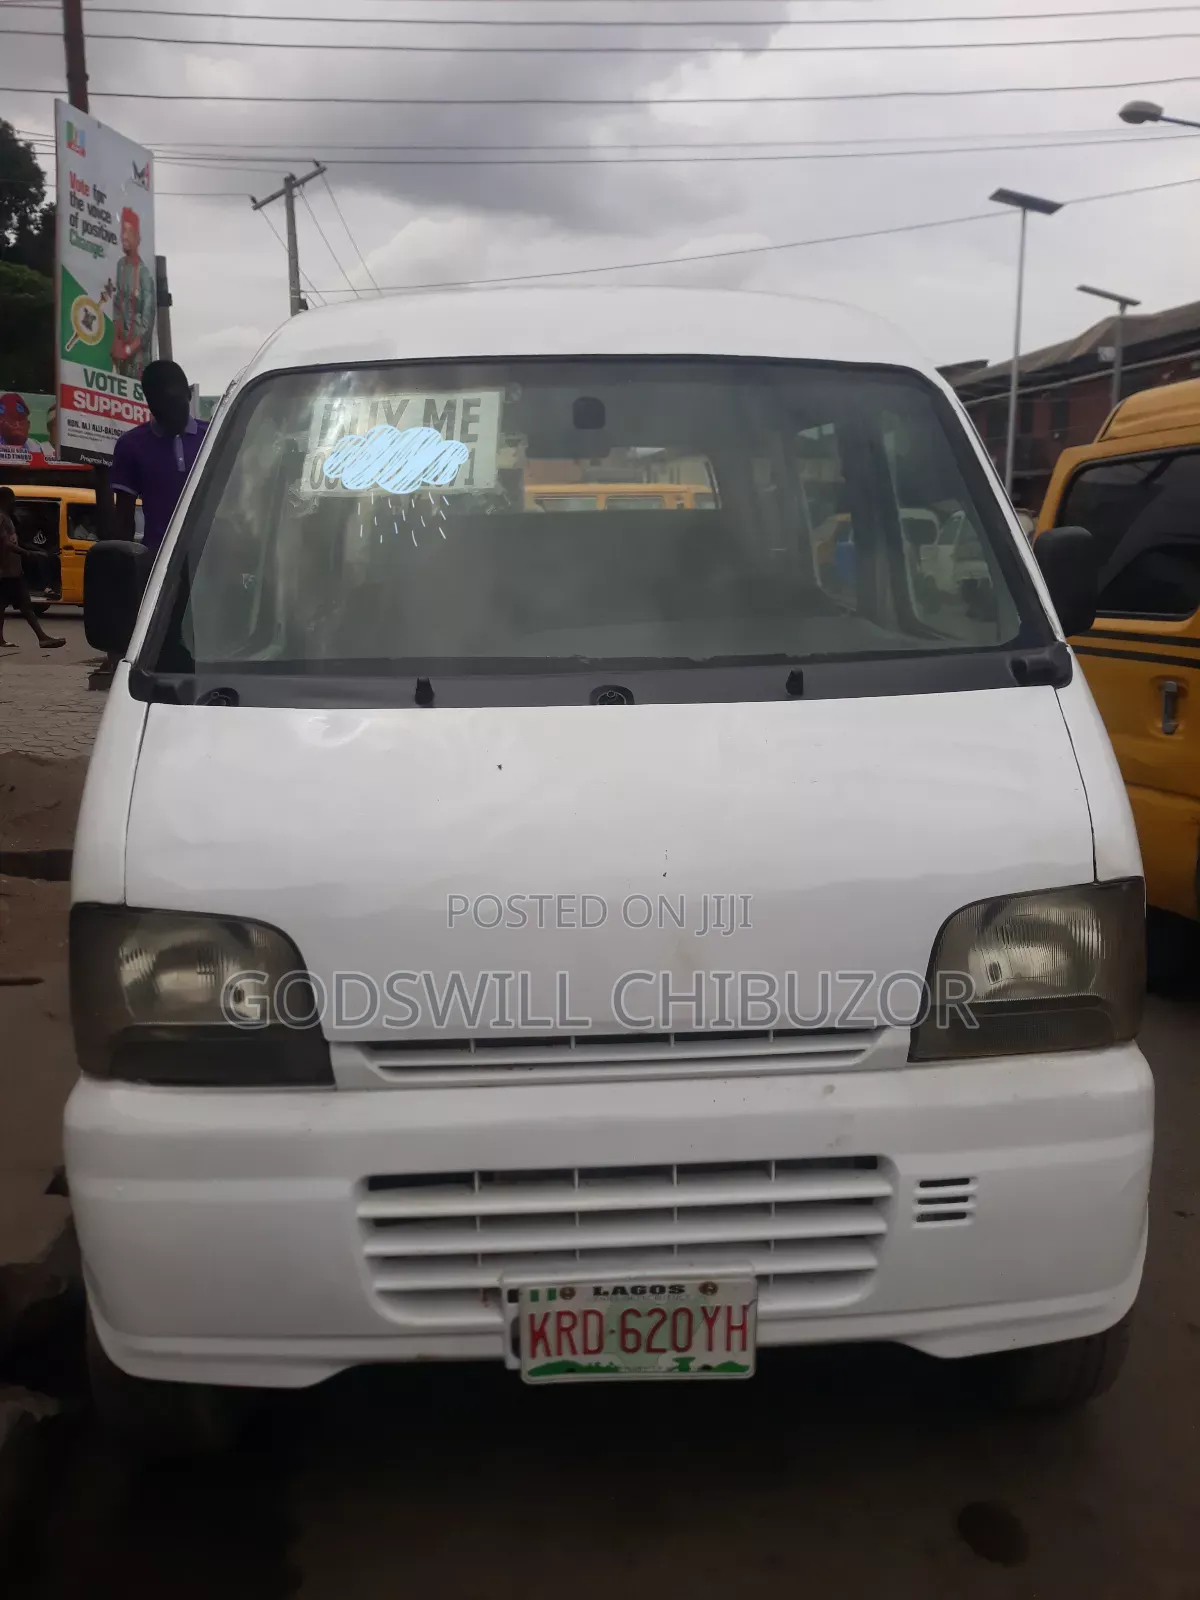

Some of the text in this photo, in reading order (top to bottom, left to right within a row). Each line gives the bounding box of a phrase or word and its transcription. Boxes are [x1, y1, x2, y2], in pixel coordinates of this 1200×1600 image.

[69, 170, 90, 197] Vote
[69, 190, 112, 224] the voice
[69, 211, 118, 246] of positive
[83, 367, 144, 401] VOTE &
[73, 390, 152, 424] SUPPORT
[423, 398, 482, 443] ME
[80, 454, 102, 465] Progress
[592, 1283, 686, 1297] LAGOS
